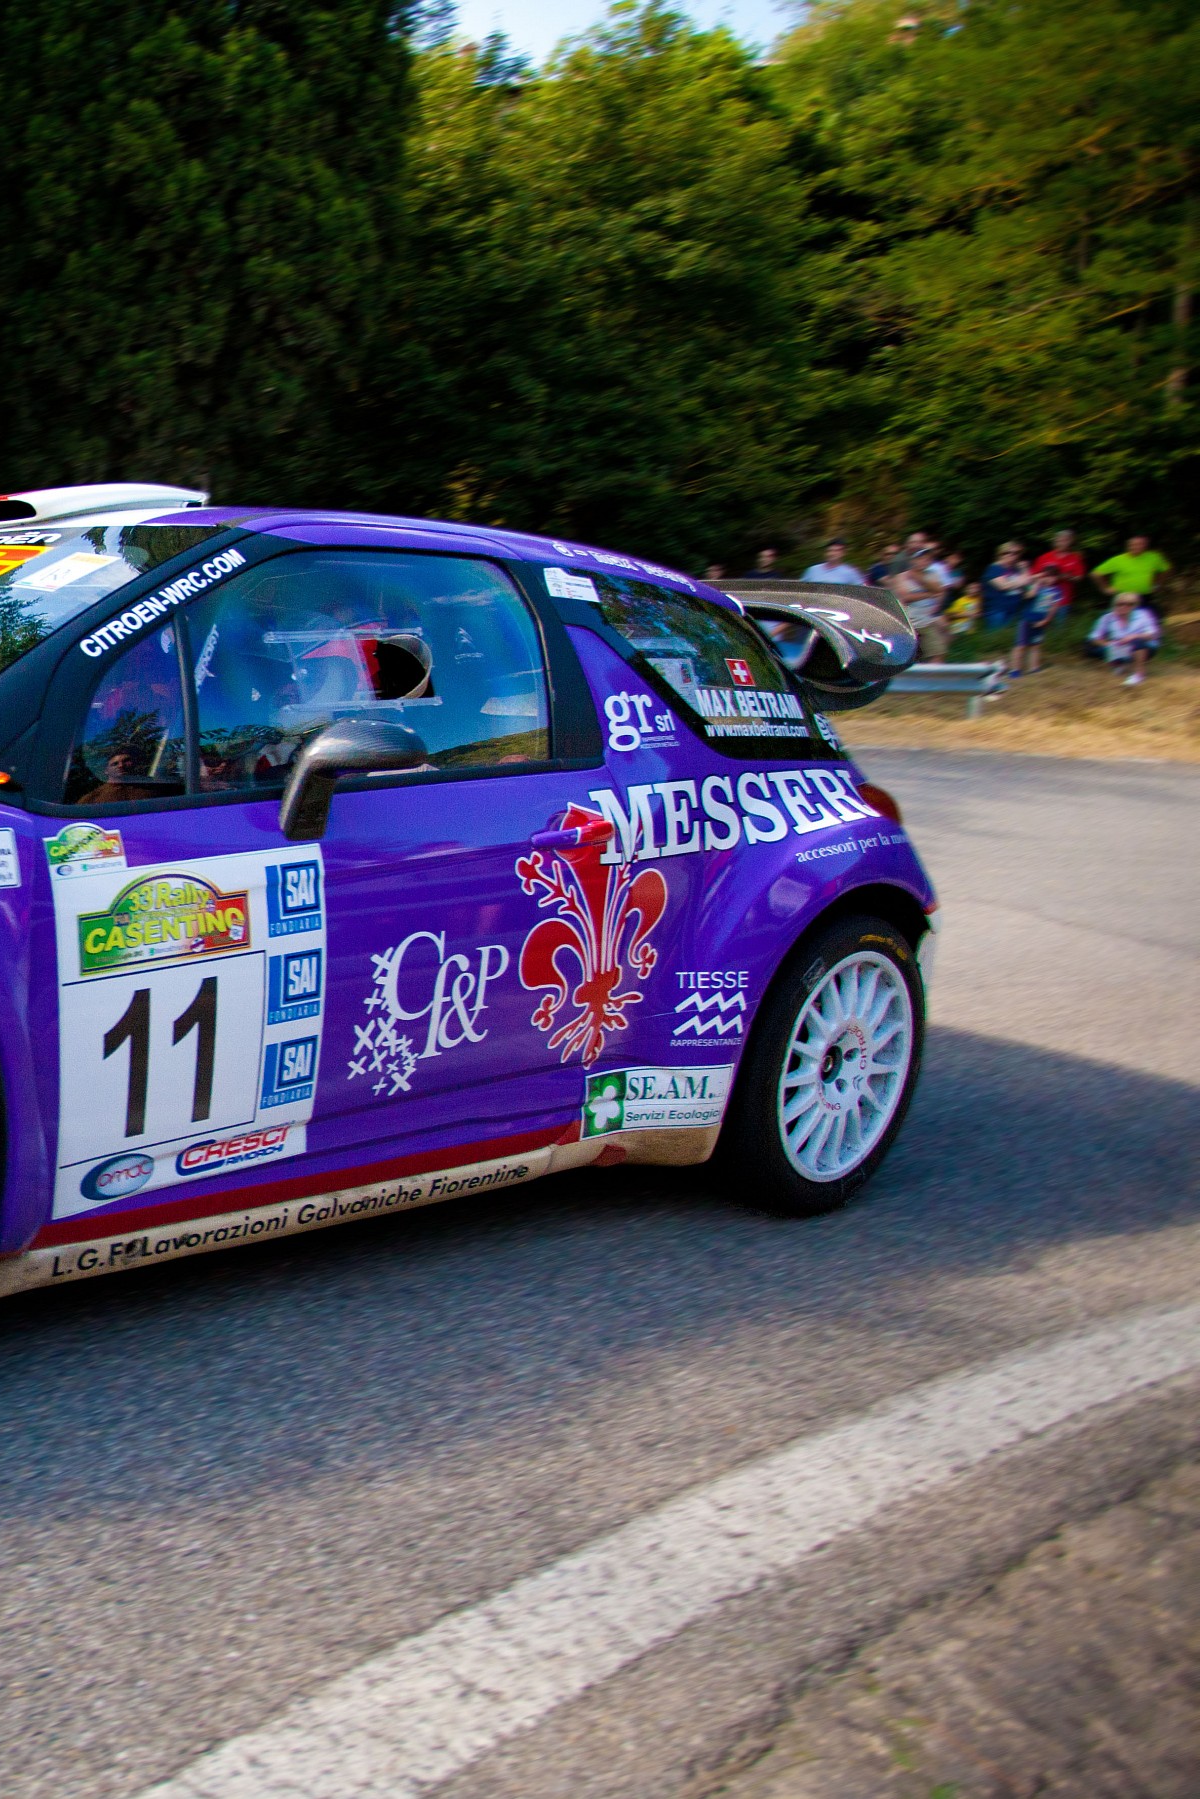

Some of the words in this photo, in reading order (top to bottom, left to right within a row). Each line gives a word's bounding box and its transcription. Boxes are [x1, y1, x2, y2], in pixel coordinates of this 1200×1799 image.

[80, 549, 246, 657] CITROEN-WRC.COM
[695, 690, 737, 718] MAX
[604, 691, 653, 751] gr
[654, 709, 676, 732] srl
[704, 722, 810, 738] www.maxbeltrami.com
[795, 836, 857, 862] accessori
[858, 837, 878, 853] per
[877, 833, 891, 846] la
[129, 885, 154, 912] 33
[156, 882, 211, 910] Rally
[287, 868, 316, 908] SAI
[85, 908, 245, 954] CASENTINO
[288, 957, 318, 995] SAI
[675, 971, 749, 989] TIESSE
[103, 976, 218, 1138] 11
[670, 1037, 743, 1047] RAPPRESENTANZE
[283, 1043, 313, 1080] SAI
[626, 1076, 714, 1100] SE.AM.
[625, 1110, 665, 1122] Servizi
[183, 1126, 291, 1167] CRESCI
[226, 1145, 285, 1166] RIMORCHI
[141, 1207, 289, 1258] Lavorazioni
[297, 1184, 422, 1225] Galvaniche
[428, 1164, 530, 1198] Fiorentine
